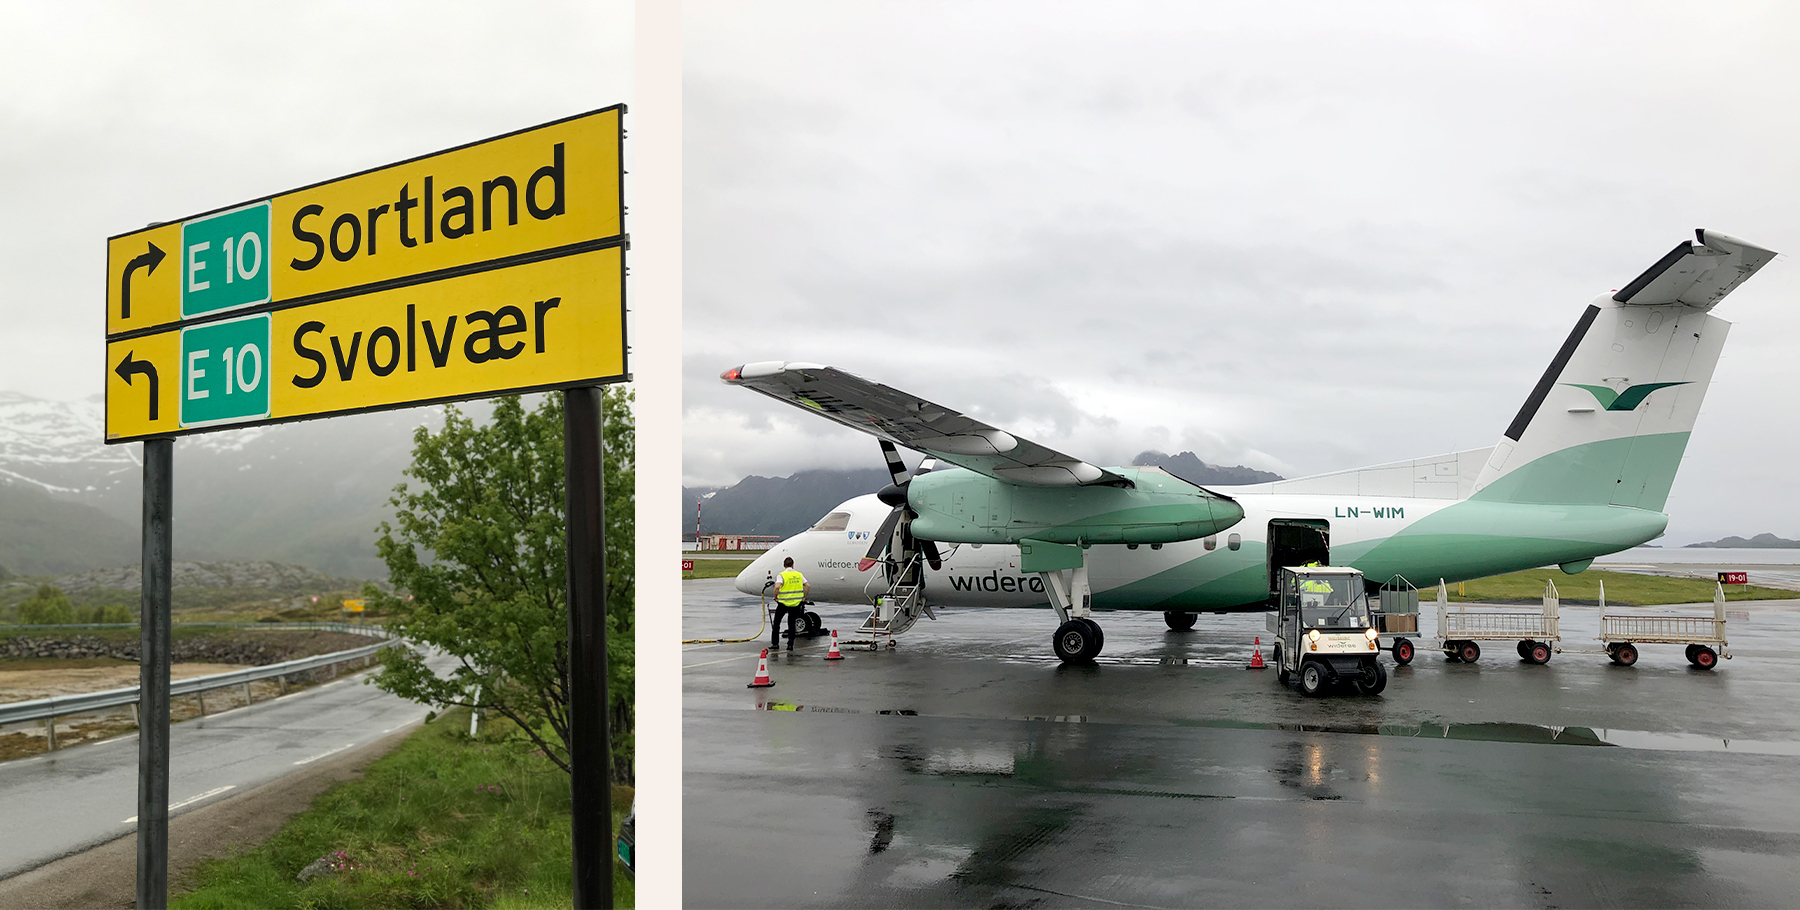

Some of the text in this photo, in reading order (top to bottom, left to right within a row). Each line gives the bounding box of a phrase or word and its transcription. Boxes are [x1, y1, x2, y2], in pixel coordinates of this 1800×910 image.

[188, 142, 566, 293] E 10 Sortland
[187, 298, 562, 400] E 10 Svolvær
[1335, 506, 1404, 518] LN-WIM
[949, 570, 1047, 593] widerø
[1720, 574, 1746, 582] A 19-01
